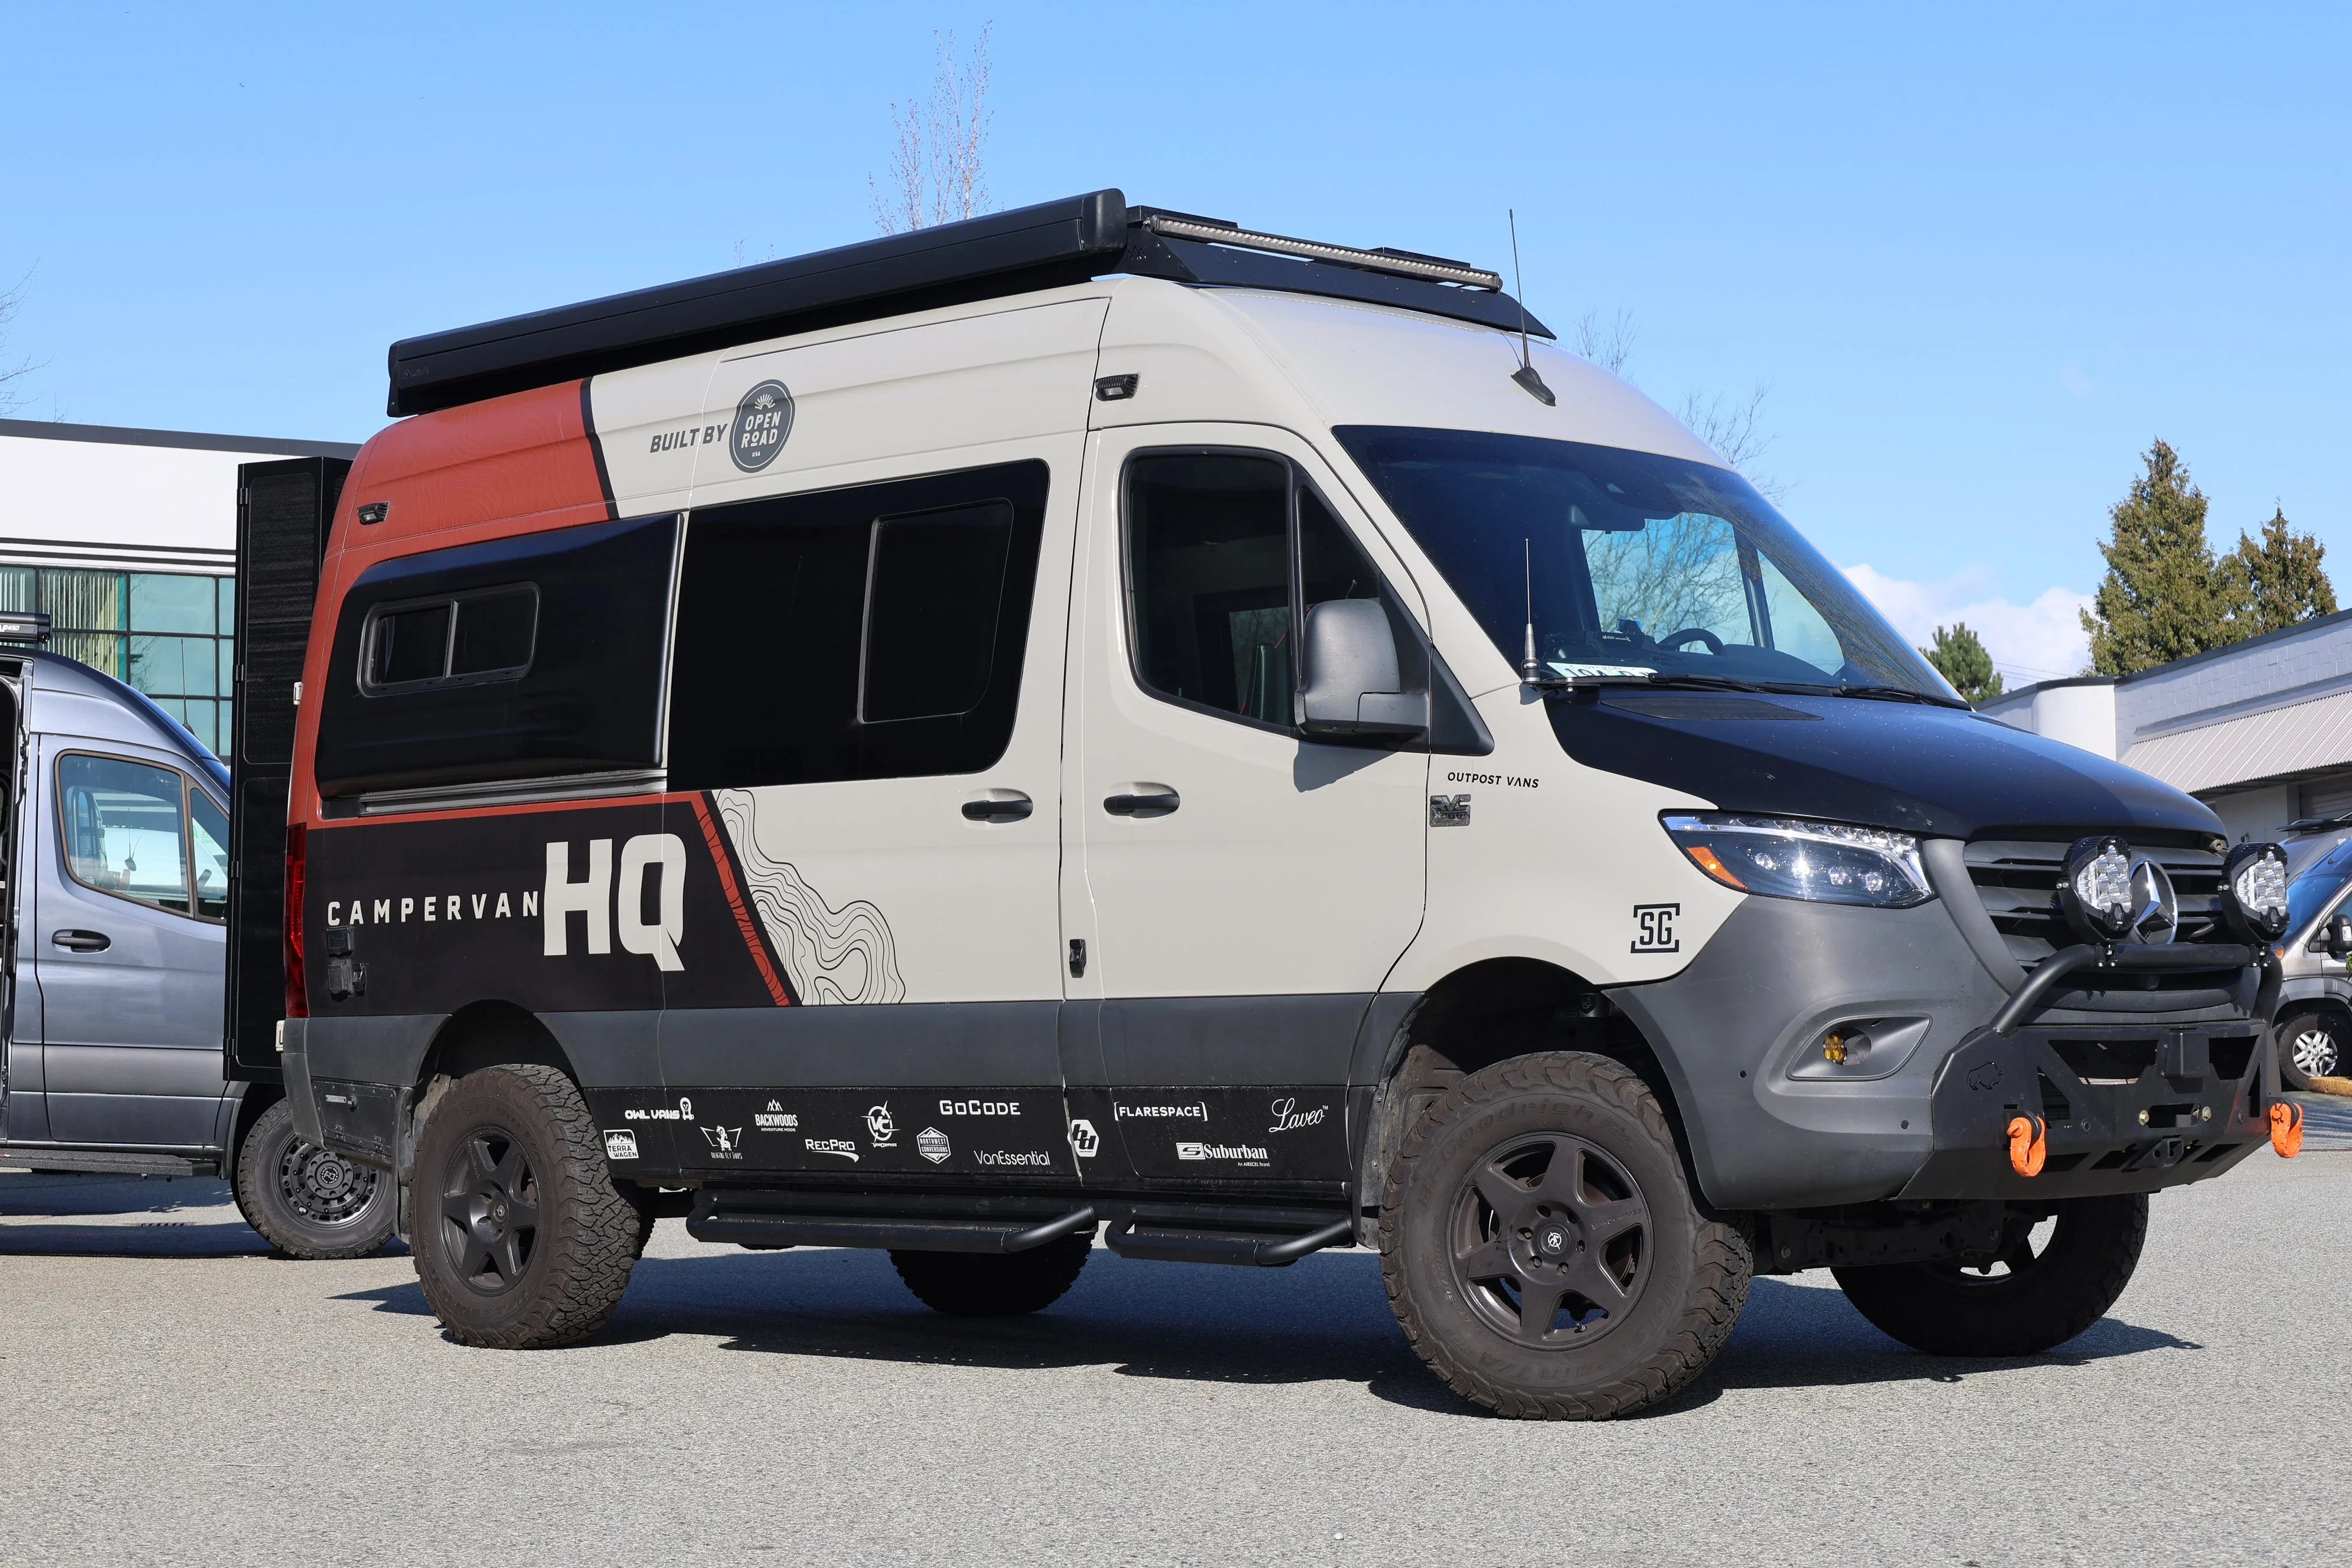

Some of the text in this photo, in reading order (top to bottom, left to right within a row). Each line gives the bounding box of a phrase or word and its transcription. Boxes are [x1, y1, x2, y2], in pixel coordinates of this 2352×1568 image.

[745, 411, 782, 432] OPEN
[650, 423, 728, 453] BUILT BY
[741, 429, 778, 449] ROAD
[1448, 772, 1539, 788] OUTPOST VANS
[327, 833, 686, 971] CAMPERVAN HQ
[1639, 911, 1672, 945] SG
[625, 1110, 680, 1119] OWL VANS
[755, 1114, 798, 1126] BACKWOODS
[1269, 1097, 1325, 1133] Laveo
[919, 1137, 946, 1145] NORTHWEST
[921, 1145, 948, 1154] CONVERSIONS
[974, 1150, 1051, 1165] VanEssential
[1204, 1144, 1269, 1159] Suburban
